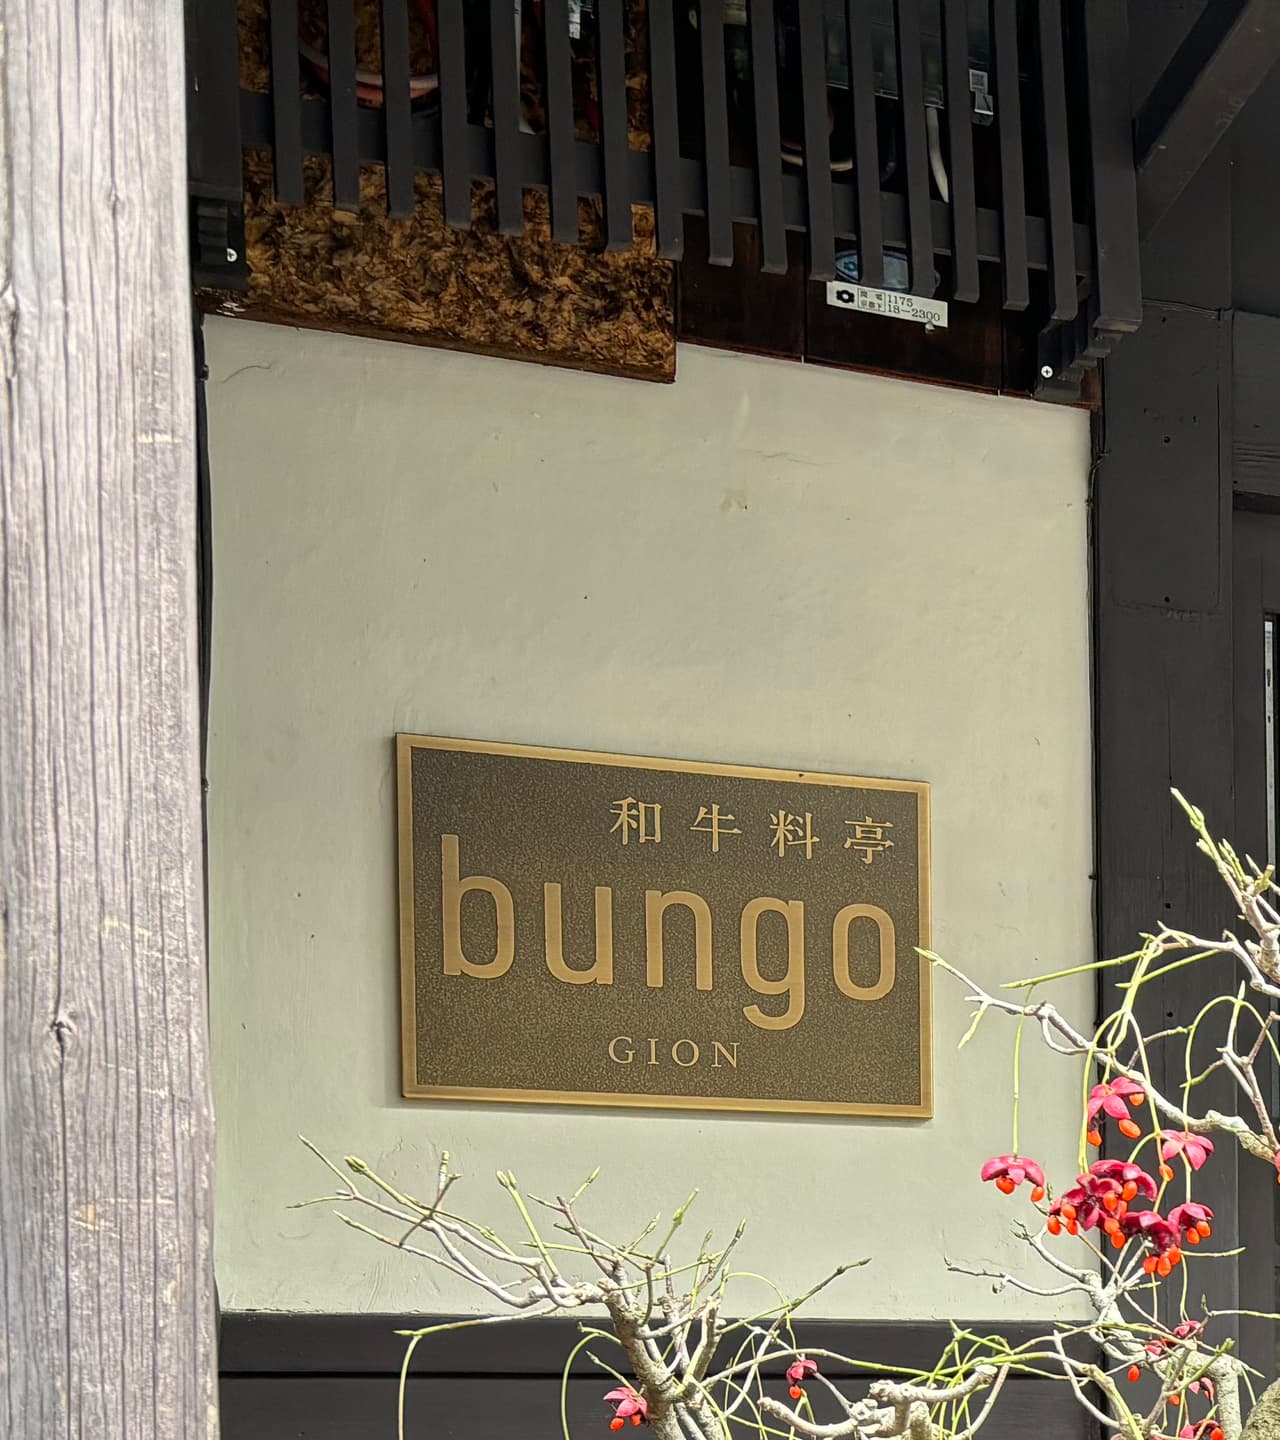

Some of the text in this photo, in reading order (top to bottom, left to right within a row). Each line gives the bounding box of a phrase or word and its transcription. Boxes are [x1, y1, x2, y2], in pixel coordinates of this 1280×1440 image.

[887, 294, 914, 308] 1175
[609, 796, 894, 864] 和牛料亭
[441, 833, 896, 1030] bungo
[608, 1036, 741, 1069] GION
